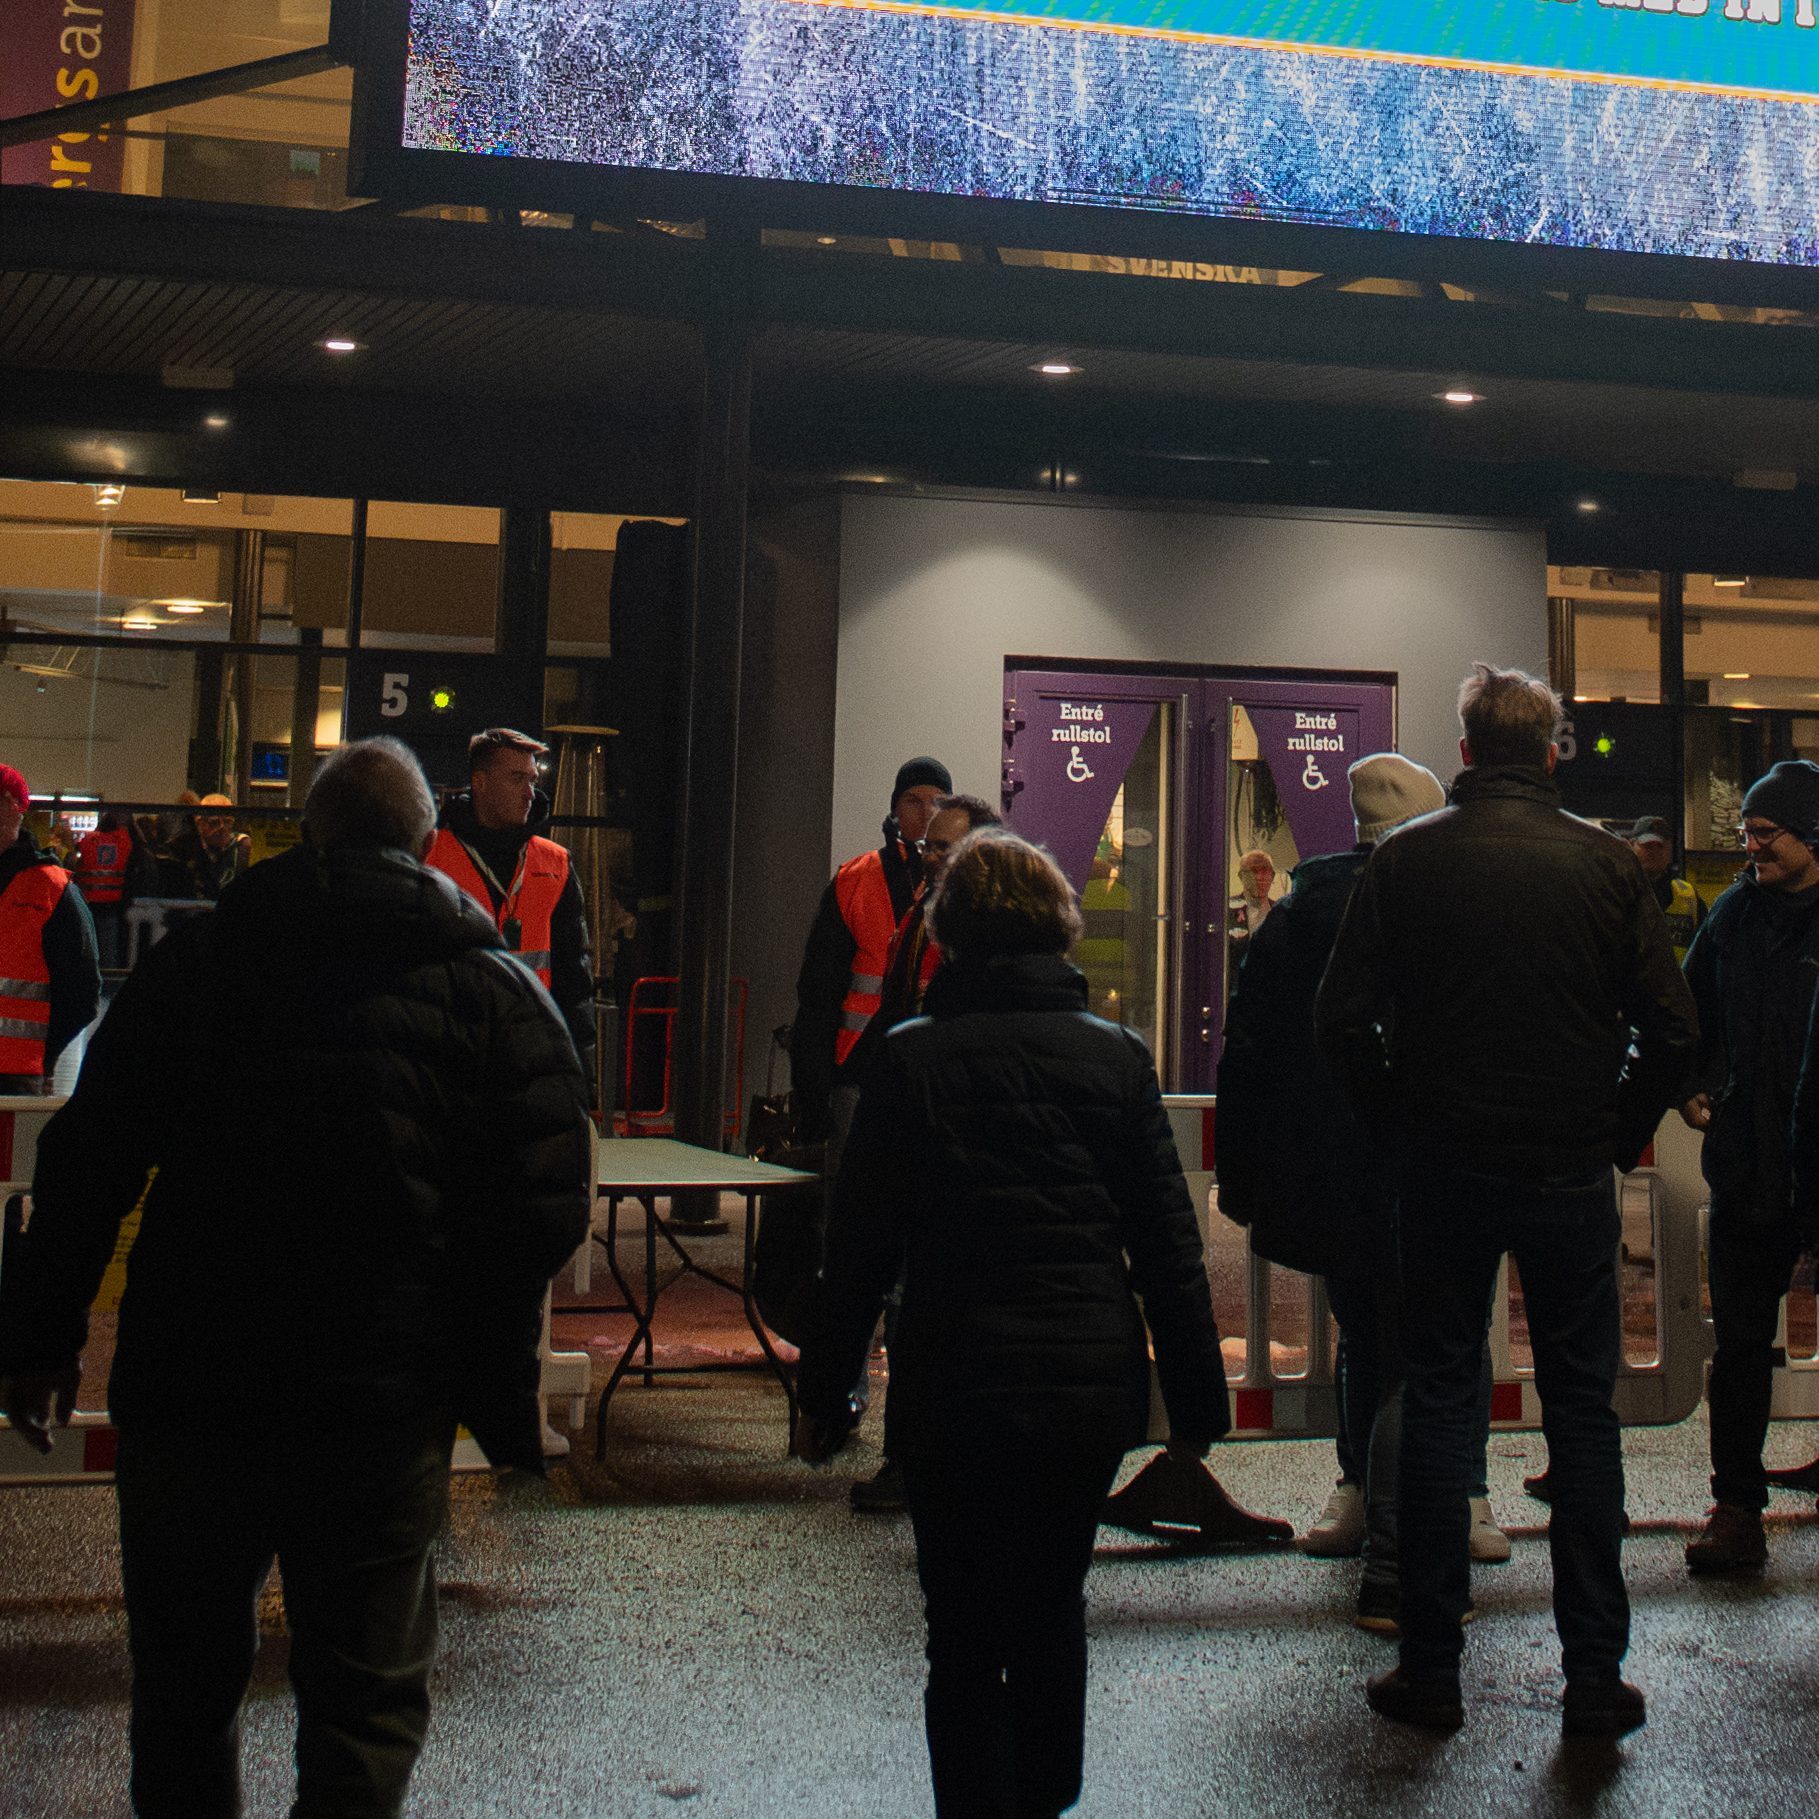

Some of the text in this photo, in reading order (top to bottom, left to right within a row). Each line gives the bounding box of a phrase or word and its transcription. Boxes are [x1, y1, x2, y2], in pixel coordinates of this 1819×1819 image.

[381, 673, 409, 717] 5
[1060, 703, 1104, 722] Entré
[1295, 712, 1337, 730] Entré
[1051, 725, 1111, 744] rullstol
[1287, 734, 1344, 752] rullstol
[1552, 721, 1577, 761] 6
